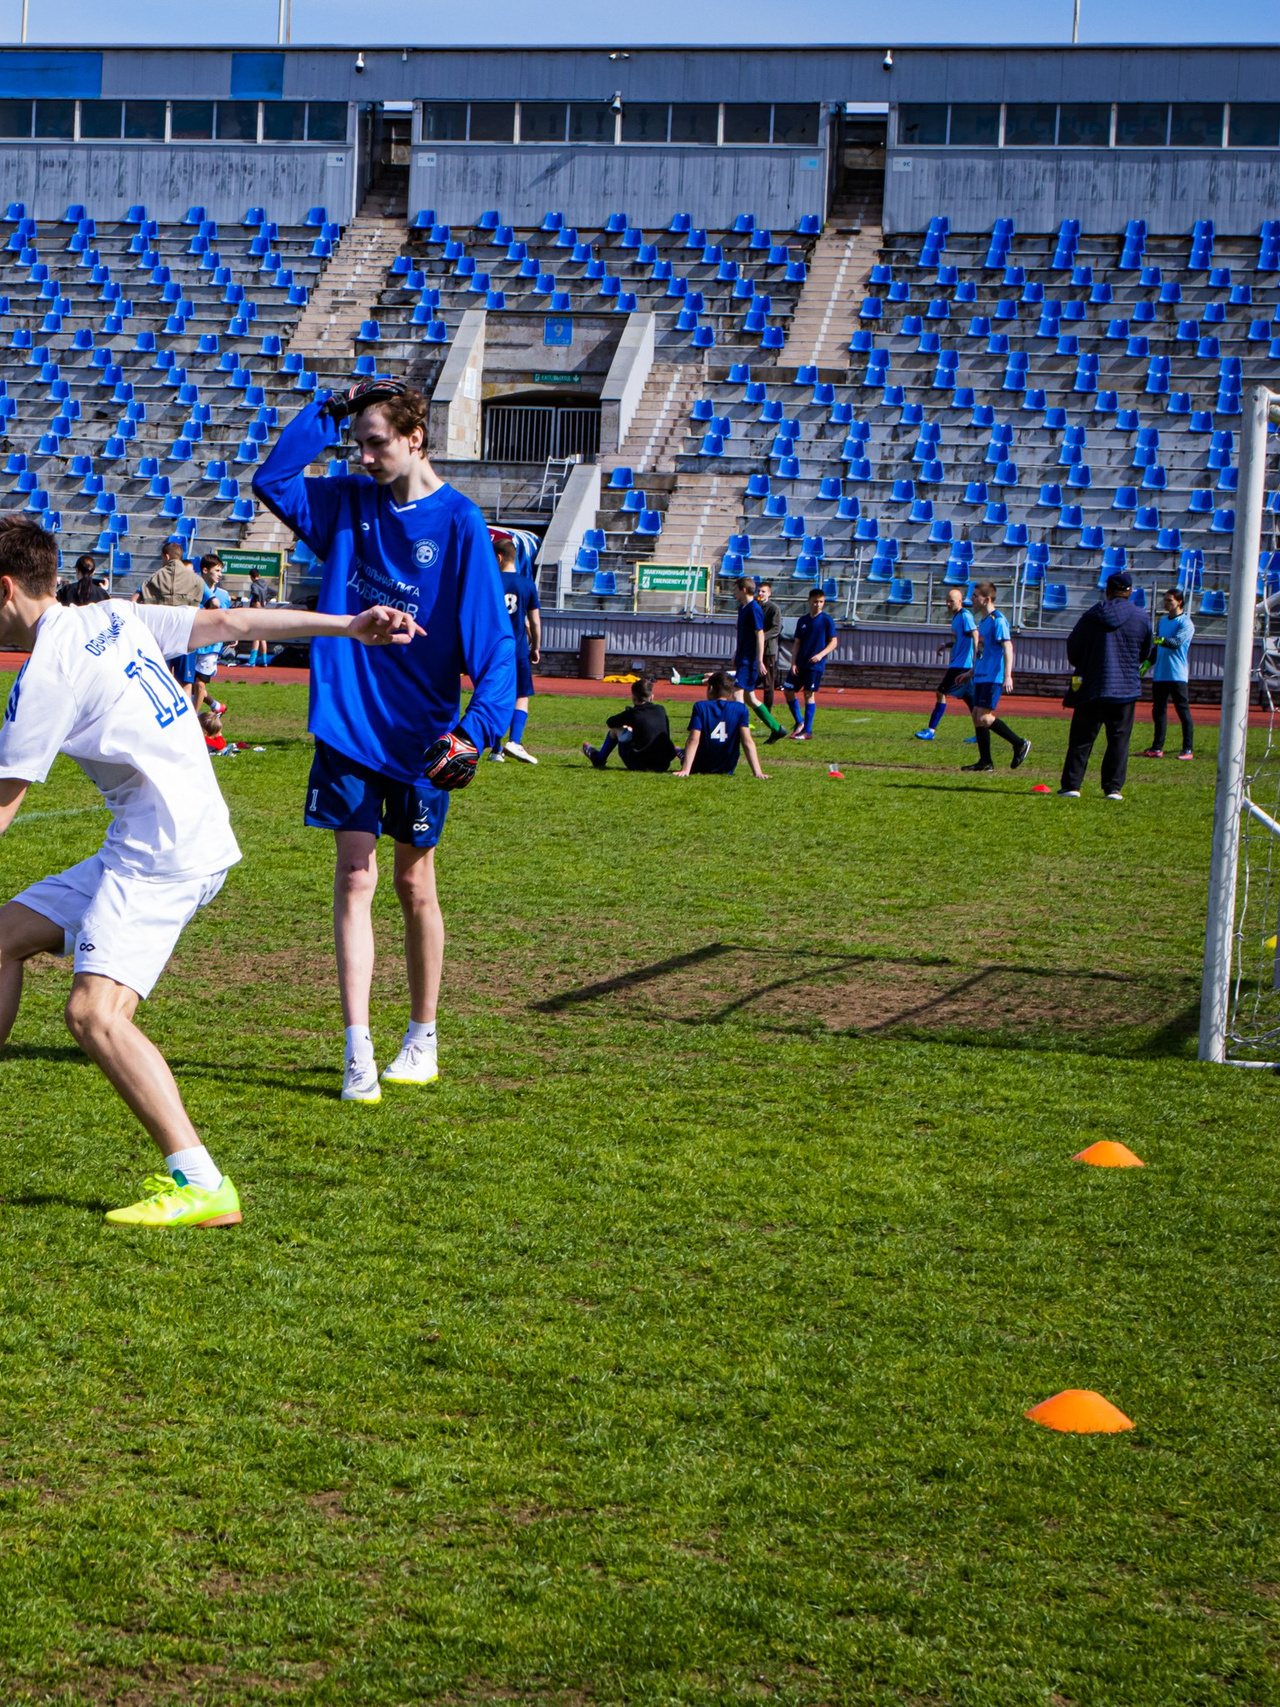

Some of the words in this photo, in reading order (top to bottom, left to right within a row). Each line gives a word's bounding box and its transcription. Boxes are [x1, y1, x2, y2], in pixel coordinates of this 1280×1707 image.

[553, 324, 564, 337] 9
[346, 570, 419, 620] ДОБРЯКОВ
[504, 593, 518, 614] 8
[124, 648, 189, 729] 11
[710, 721, 728, 742] 4
[309, 789, 319, 811] 1
